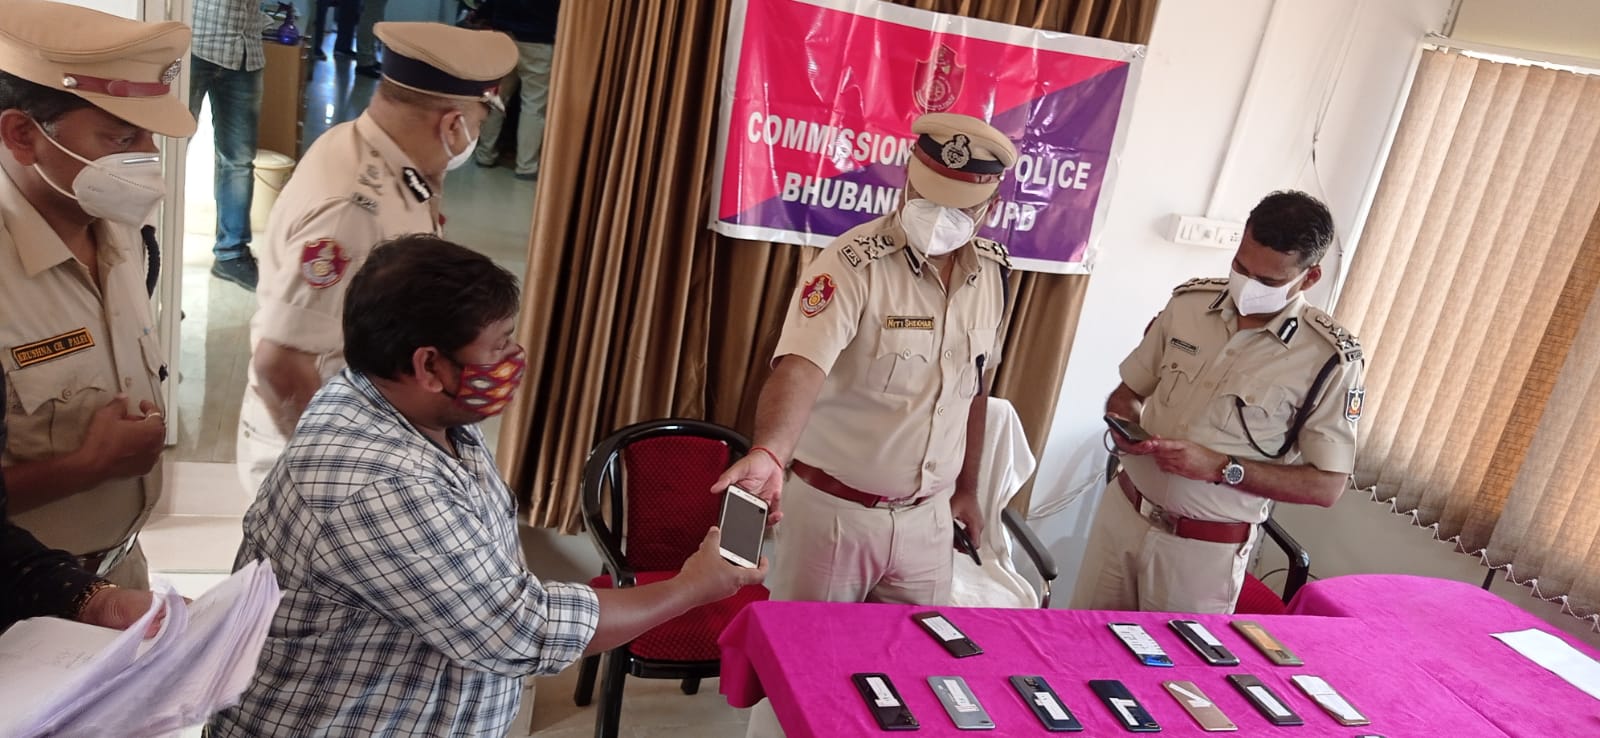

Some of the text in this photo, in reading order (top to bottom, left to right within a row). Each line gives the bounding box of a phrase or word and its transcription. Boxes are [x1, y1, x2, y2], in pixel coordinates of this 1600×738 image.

[748, 111, 1092, 190] COMMISSION OLICE
[781, 172, 902, 215] BHUBAN
